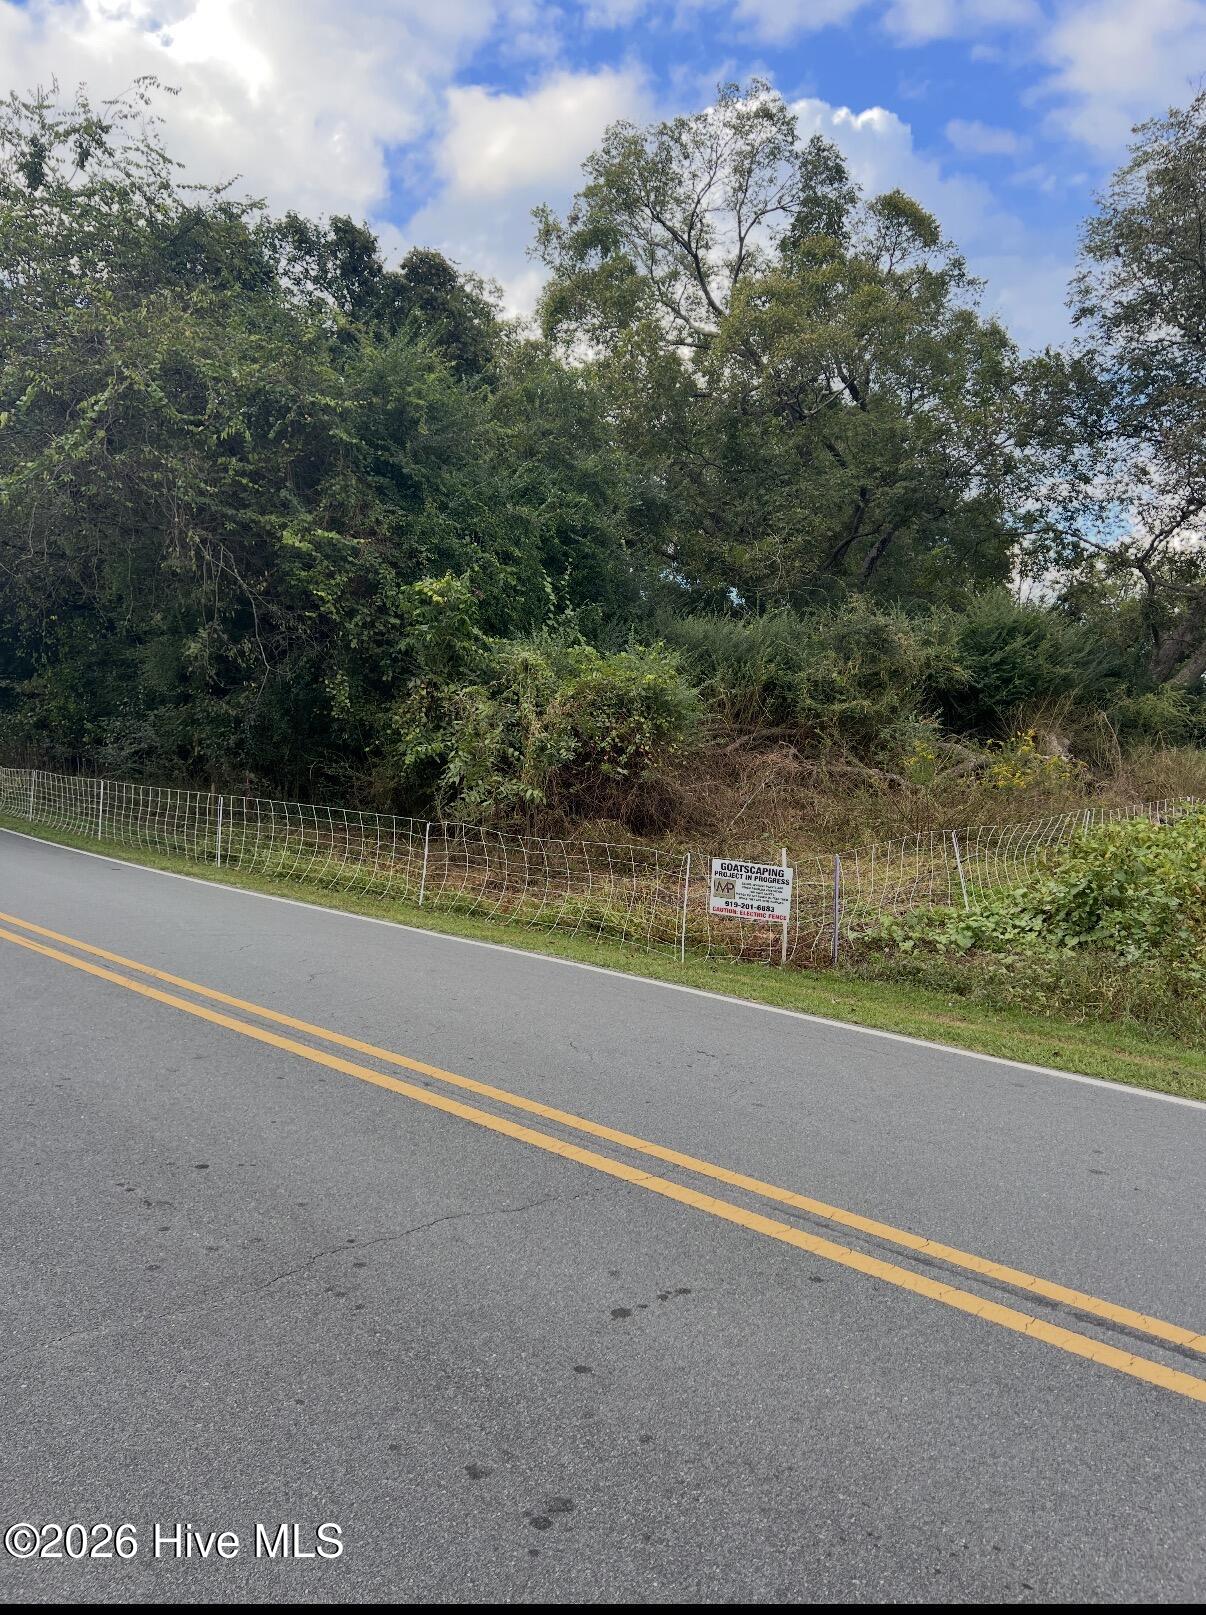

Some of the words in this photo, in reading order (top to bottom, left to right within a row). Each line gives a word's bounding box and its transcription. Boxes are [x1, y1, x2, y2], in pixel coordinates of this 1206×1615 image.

[714, 870, 743, 880] PROJECT
[754, 876, 790, 886] PROGRESS
[720, 862, 784, 878] GOATSCAPING
[740, 910, 767, 918] ELECTRIC
